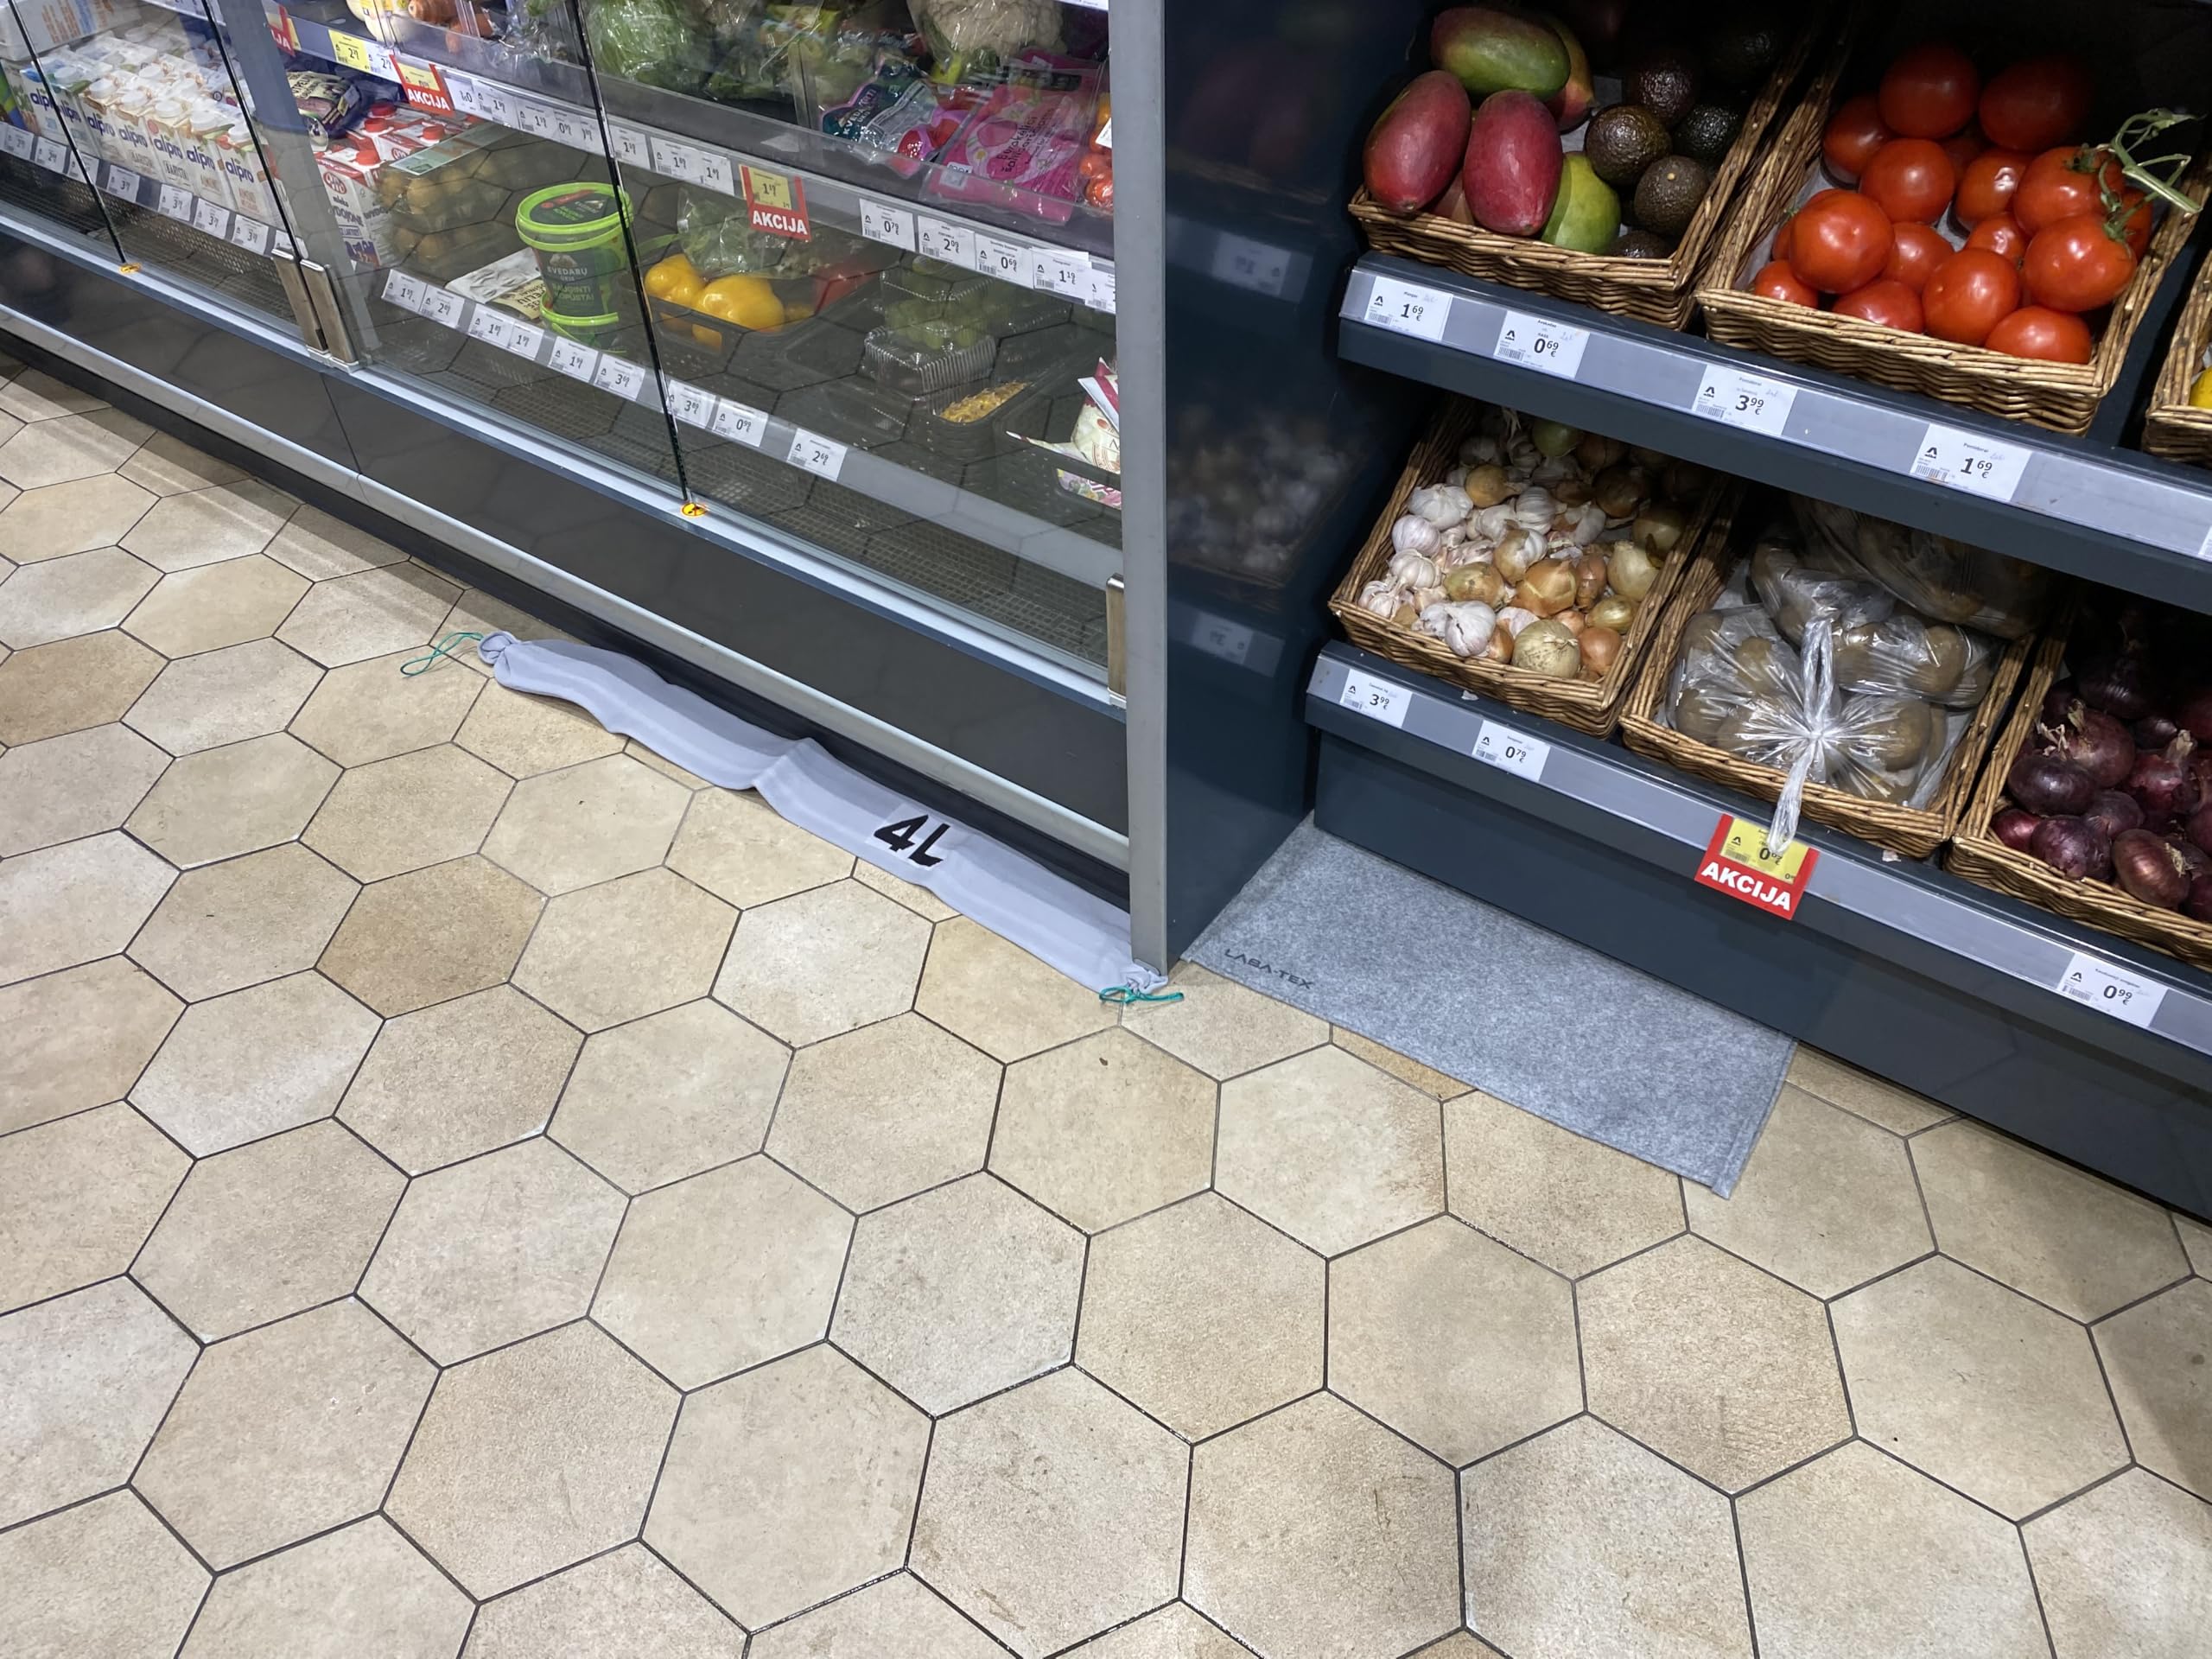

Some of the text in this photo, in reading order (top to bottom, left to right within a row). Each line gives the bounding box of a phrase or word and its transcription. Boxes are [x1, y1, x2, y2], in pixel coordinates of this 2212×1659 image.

[407, 88, 451, 111] AKCIJA
[87, 111, 115, 137] alpro
[118, 124, 148, 149] alpro
[154, 134, 183, 159] alpro
[187, 145, 216, 170] alpro
[226, 157, 254, 183] alpro
[753, 210, 808, 235] AKCIJA
[874, 814, 950, 867] 4L
[1701, 861, 1791, 912] AKCIJA
[1224, 948, 1314, 990] LABA-TEX
